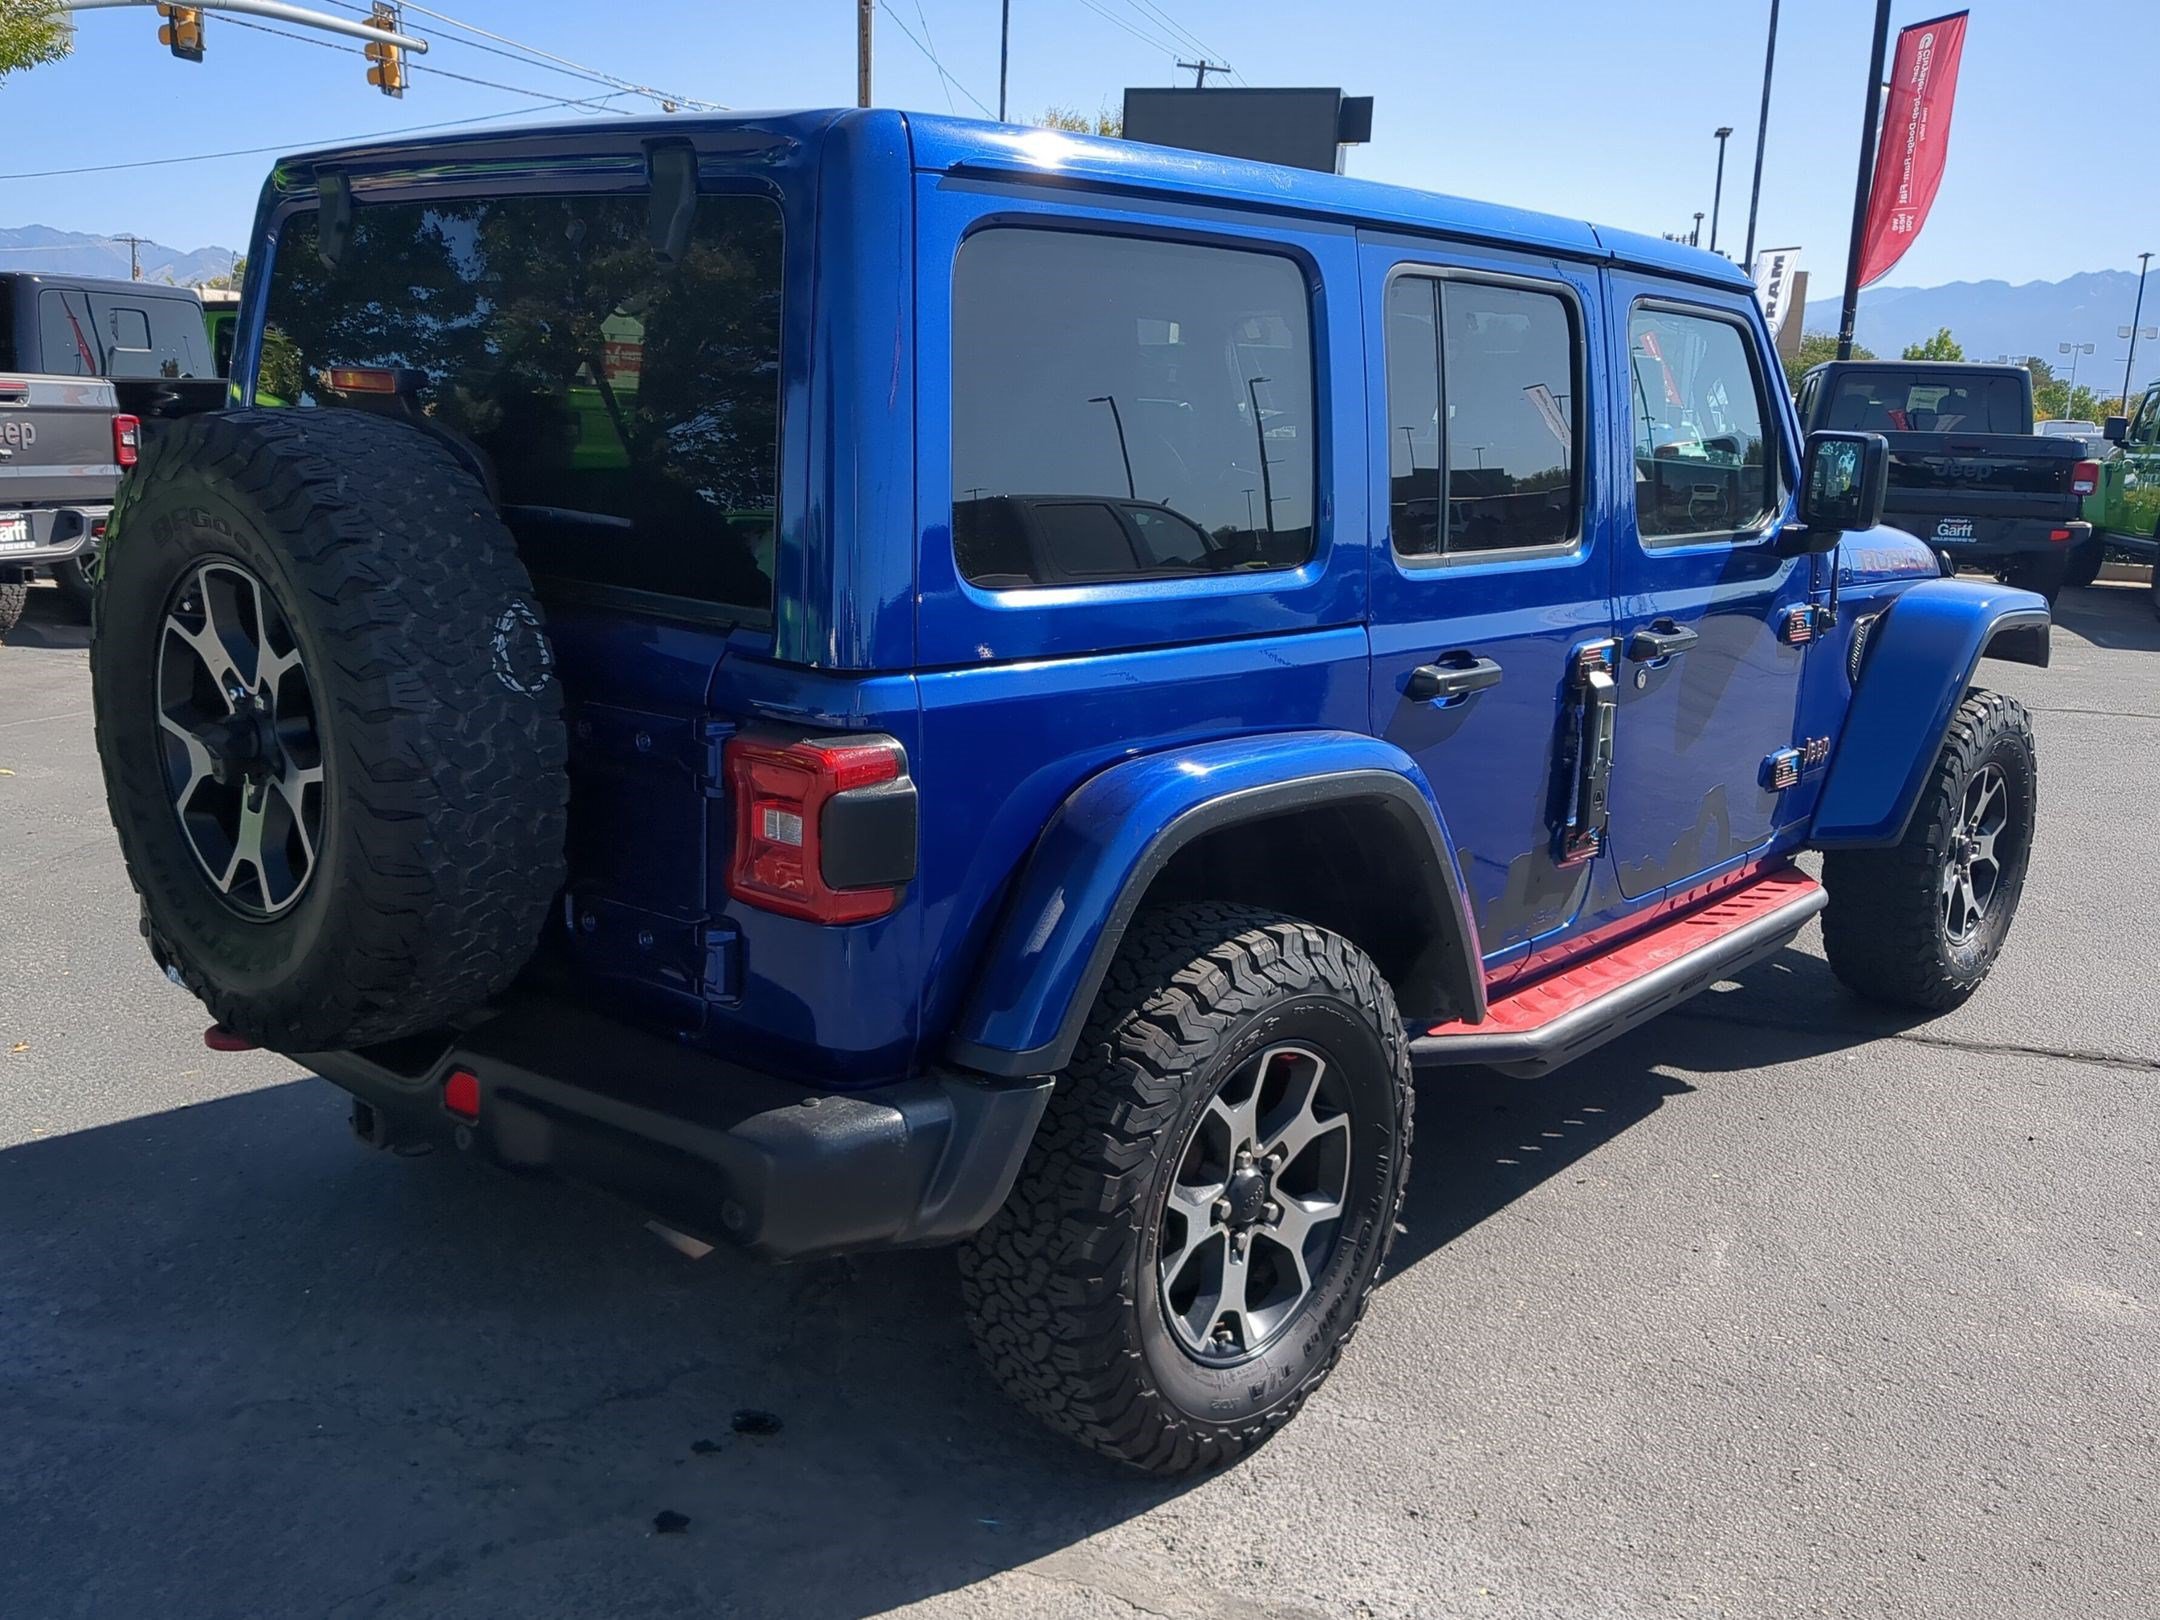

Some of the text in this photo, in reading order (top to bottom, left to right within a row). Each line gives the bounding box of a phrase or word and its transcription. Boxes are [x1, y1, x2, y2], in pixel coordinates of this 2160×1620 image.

[1765, 254, 1785, 318] RAM
[0, 422, 37, 450] ep
[1933, 459, 1992, 481] Jeep
[1937, 523, 1973, 537] Garff
